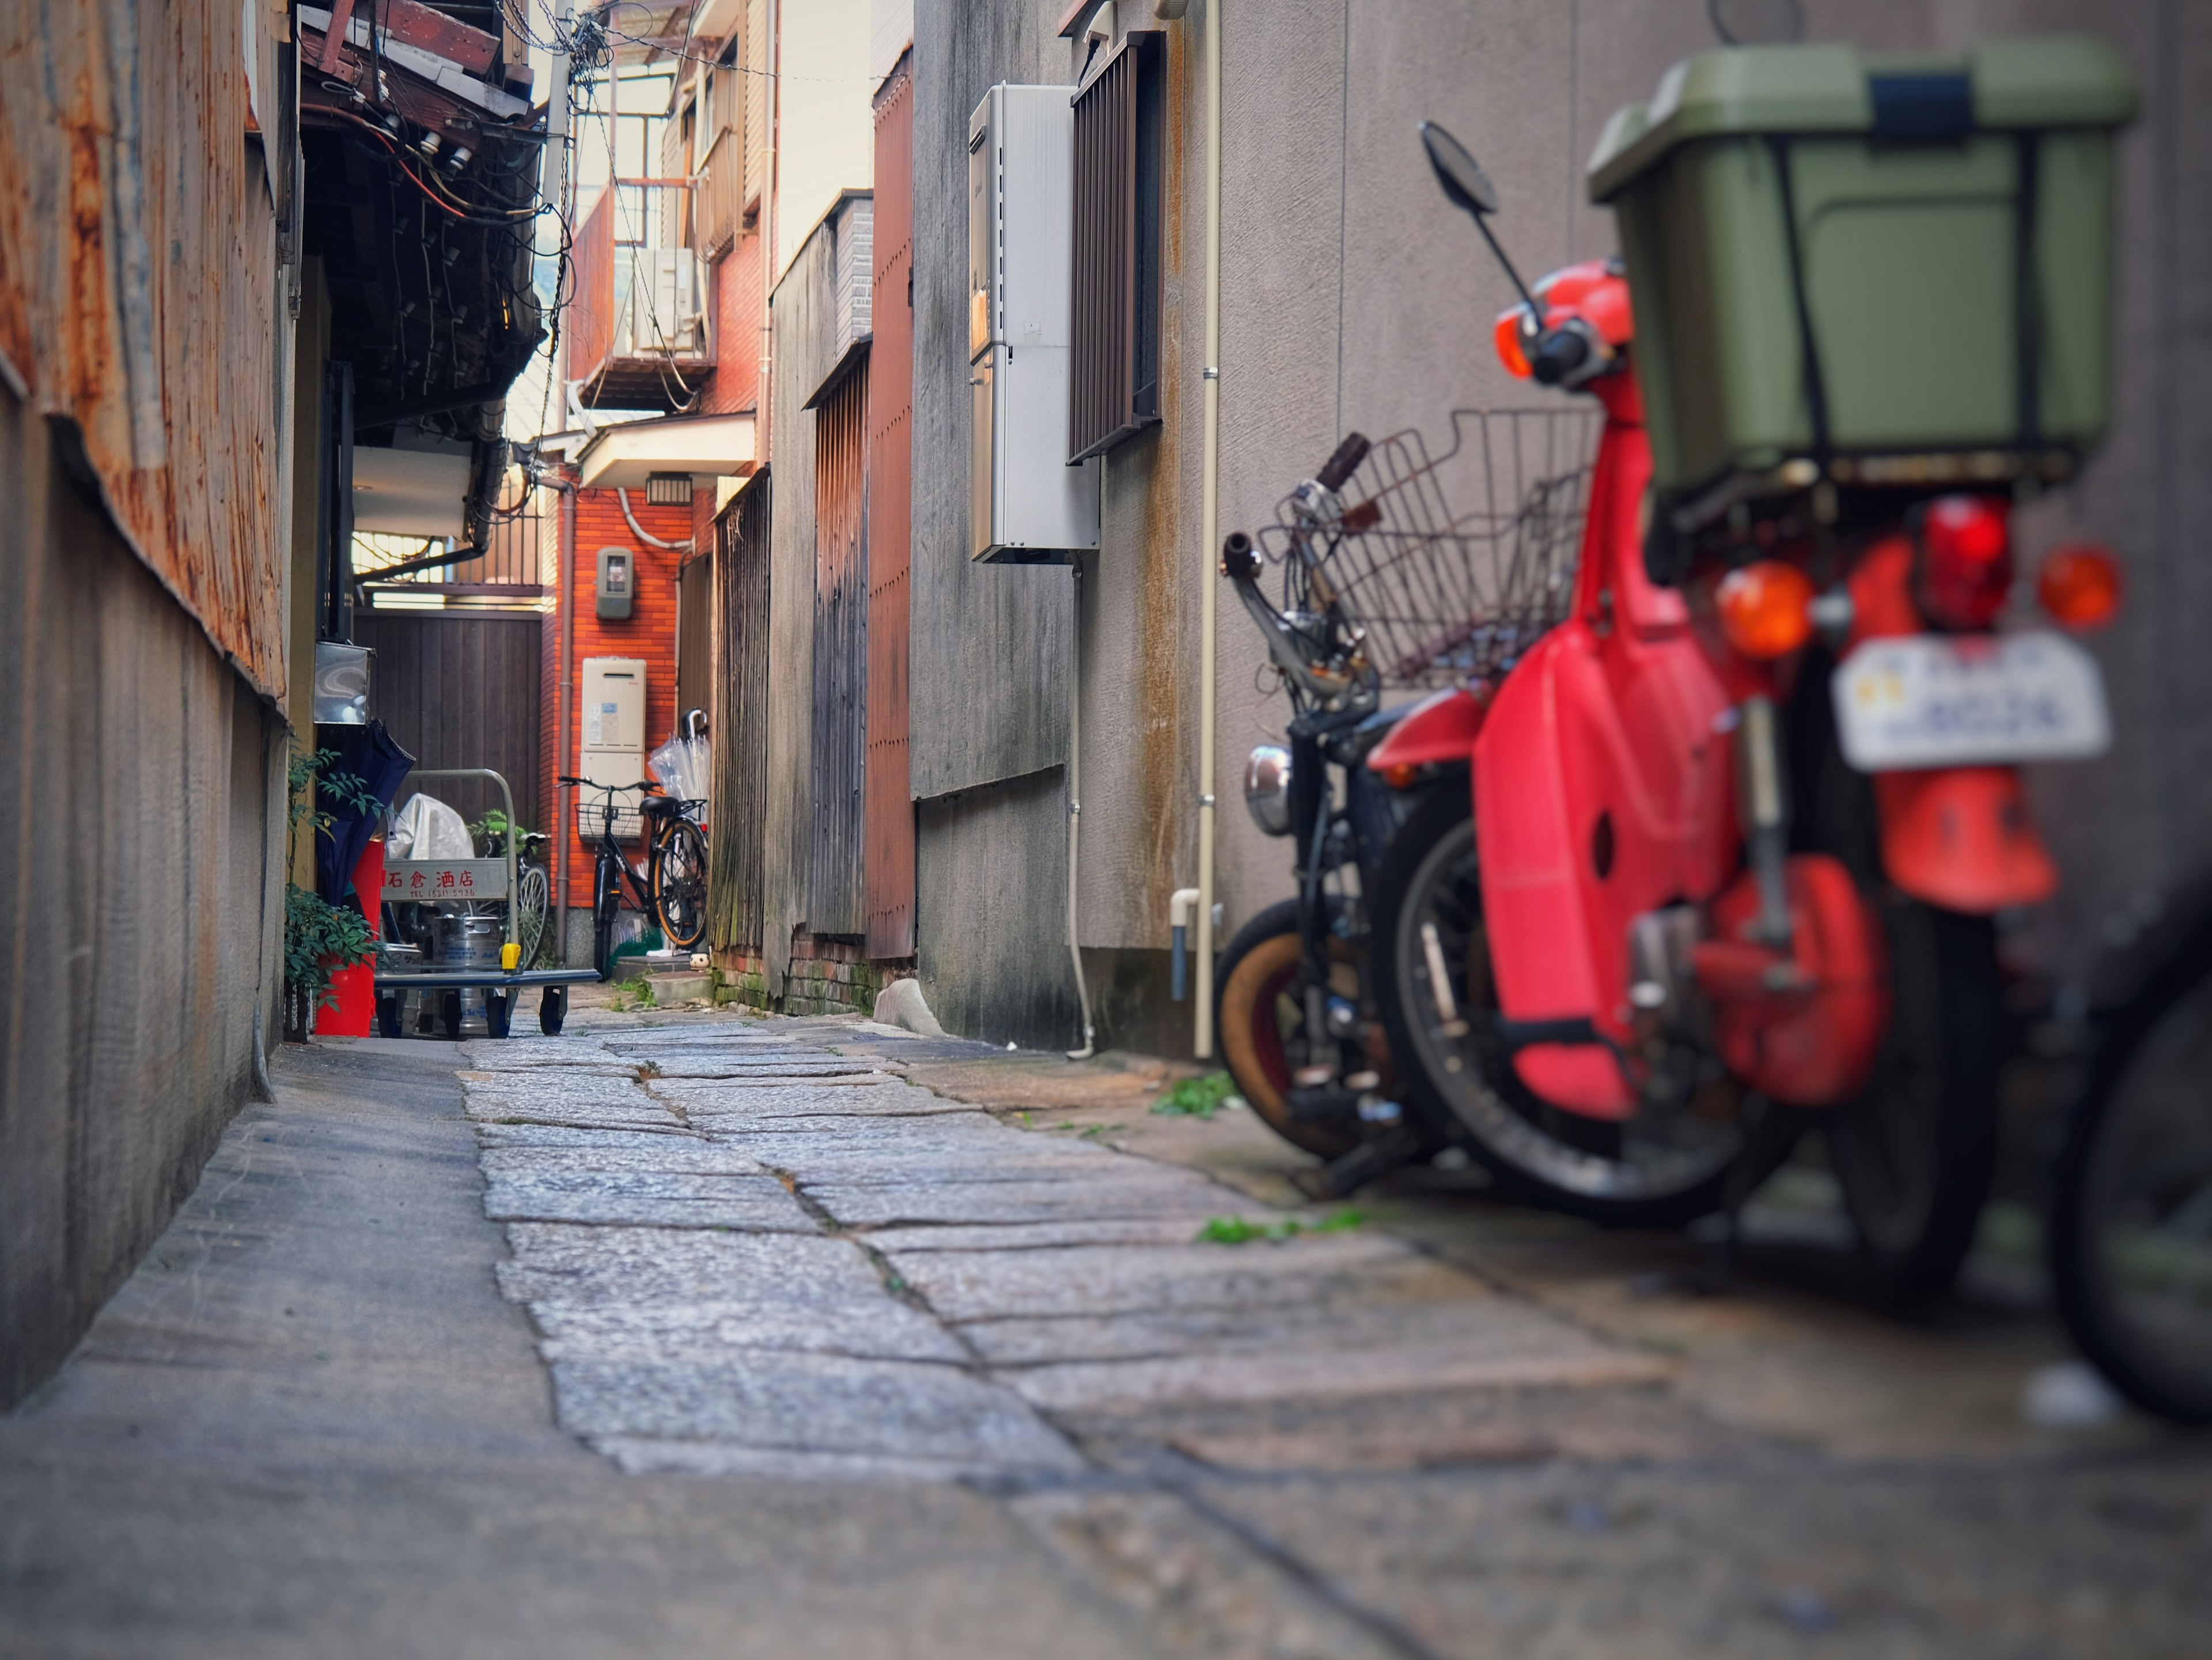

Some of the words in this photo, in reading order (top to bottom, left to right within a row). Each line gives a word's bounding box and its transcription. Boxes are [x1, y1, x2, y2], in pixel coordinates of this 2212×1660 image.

[388, 870, 474, 888] 石倉酒店
[453, 888, 475, 897] 5936
